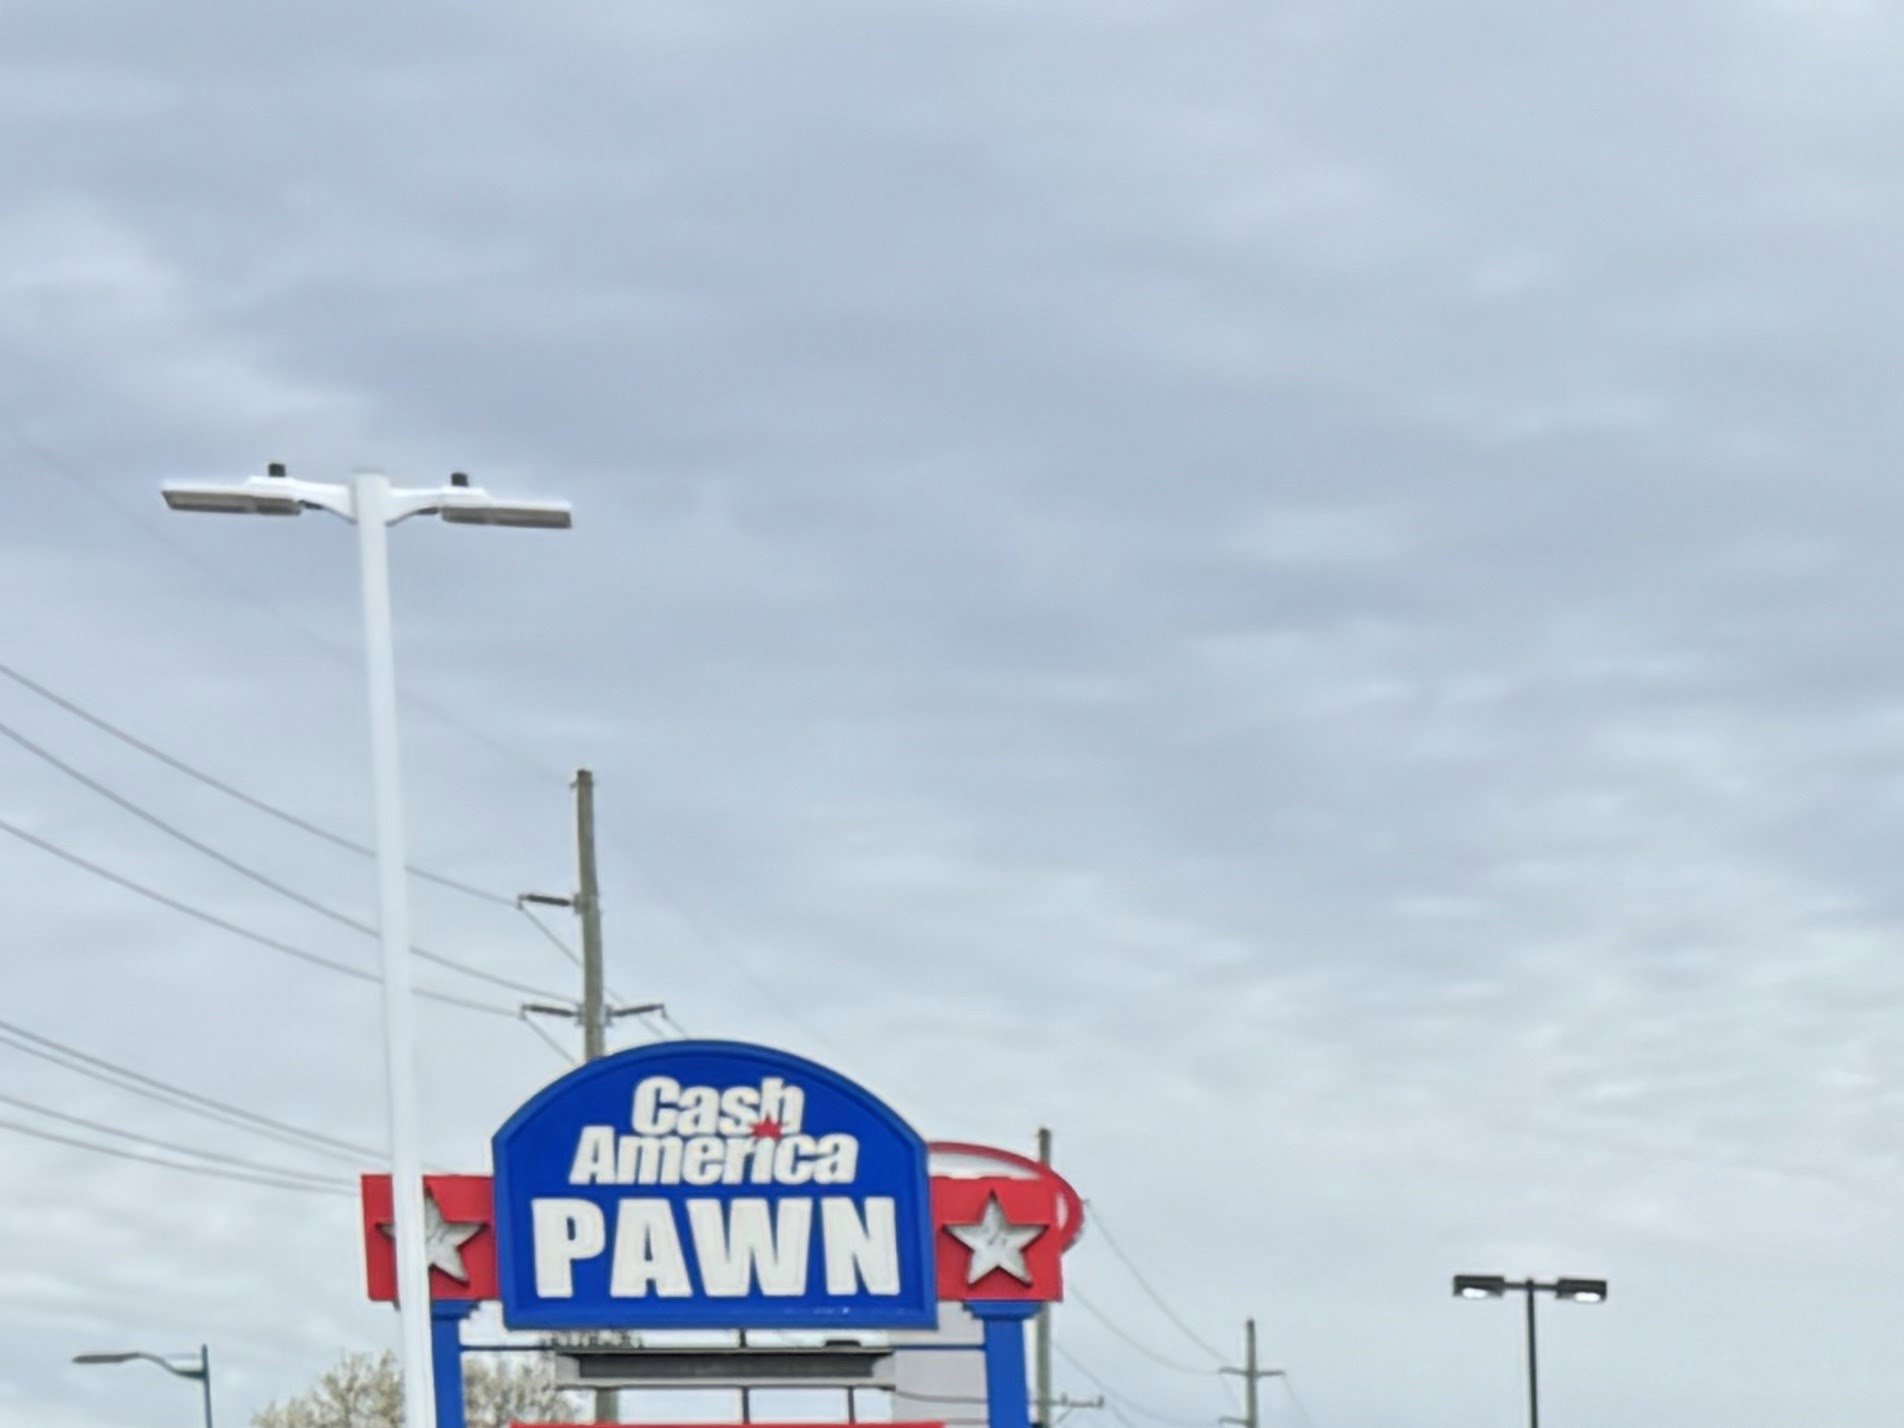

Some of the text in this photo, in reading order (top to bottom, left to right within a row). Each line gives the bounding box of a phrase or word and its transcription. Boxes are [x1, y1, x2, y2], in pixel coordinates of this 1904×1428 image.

[633, 1076, 805, 1138] Cash
[568, 1125, 859, 1185] America
[531, 1197, 901, 1299] PAWN
